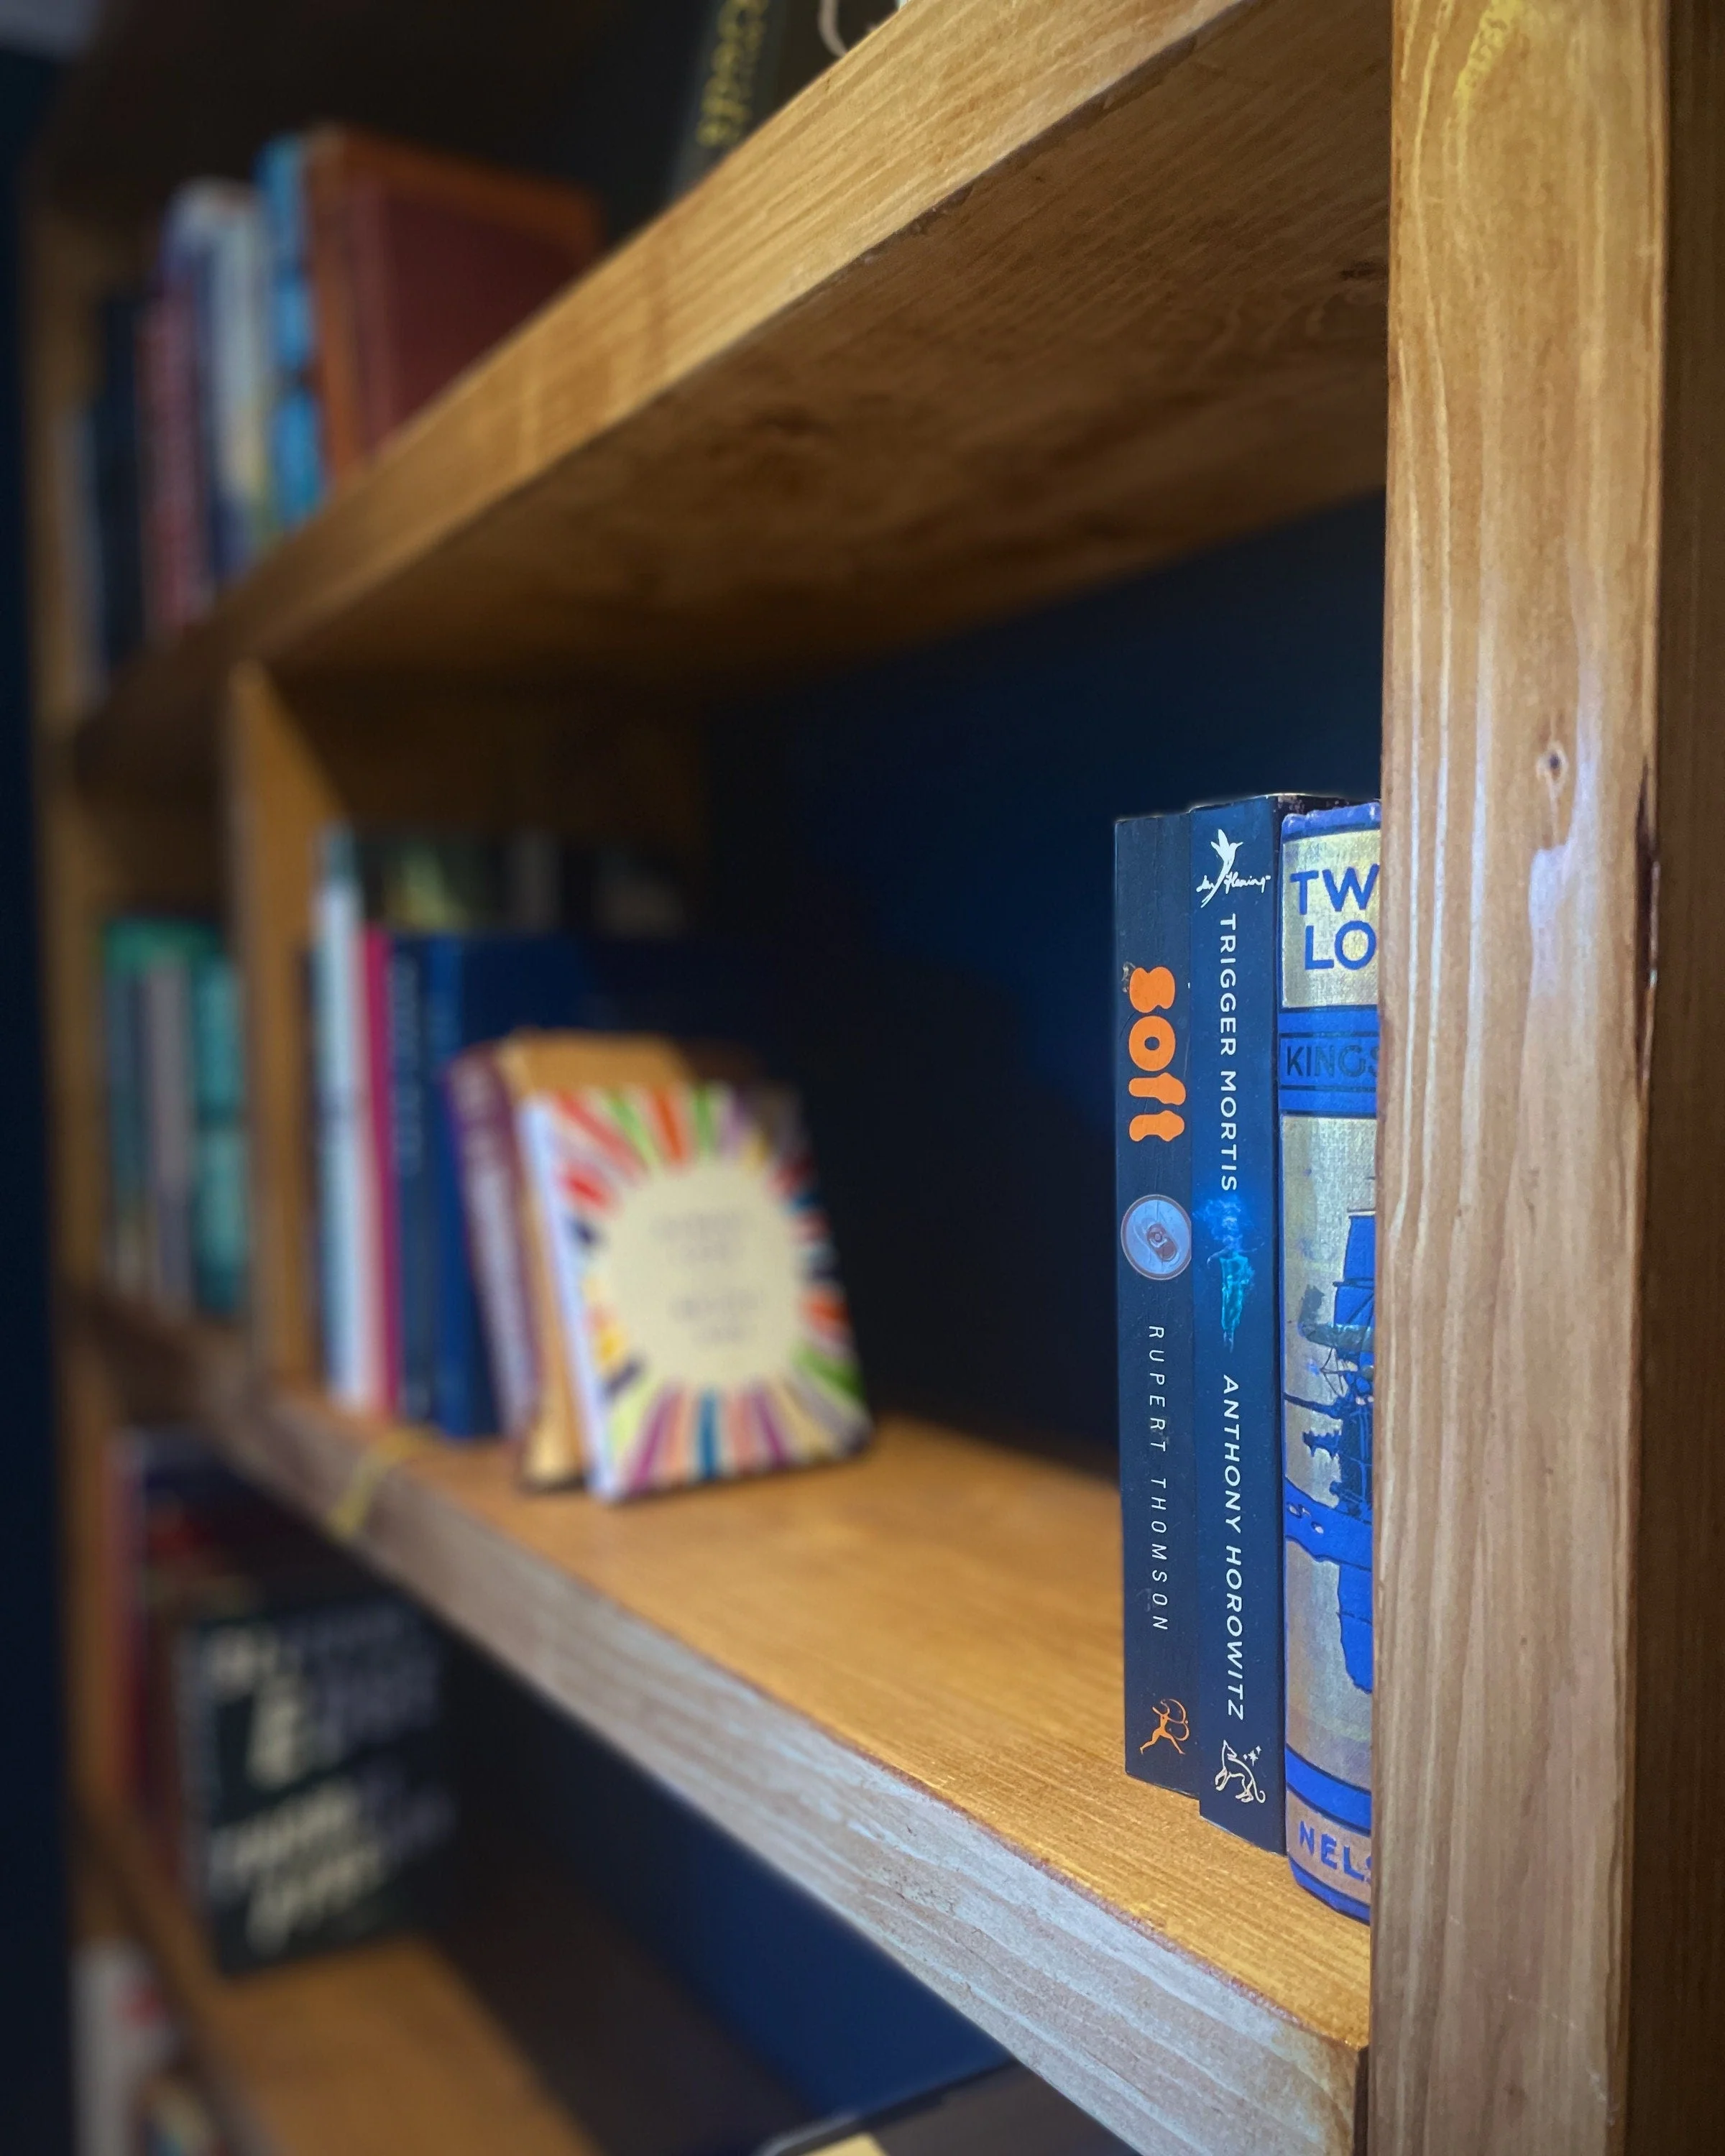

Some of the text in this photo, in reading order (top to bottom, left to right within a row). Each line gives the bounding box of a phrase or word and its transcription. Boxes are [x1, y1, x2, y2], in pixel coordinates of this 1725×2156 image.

[1220, 913, 1238, 1192] TRIGGER MORTIS
[1149, 1325, 1169, 1631] RUPERT THOMSON
[1223, 1374, 1245, 1720] ANTHONY HOROWITZ
[1299, 1820, 1372, 1884] NEL
